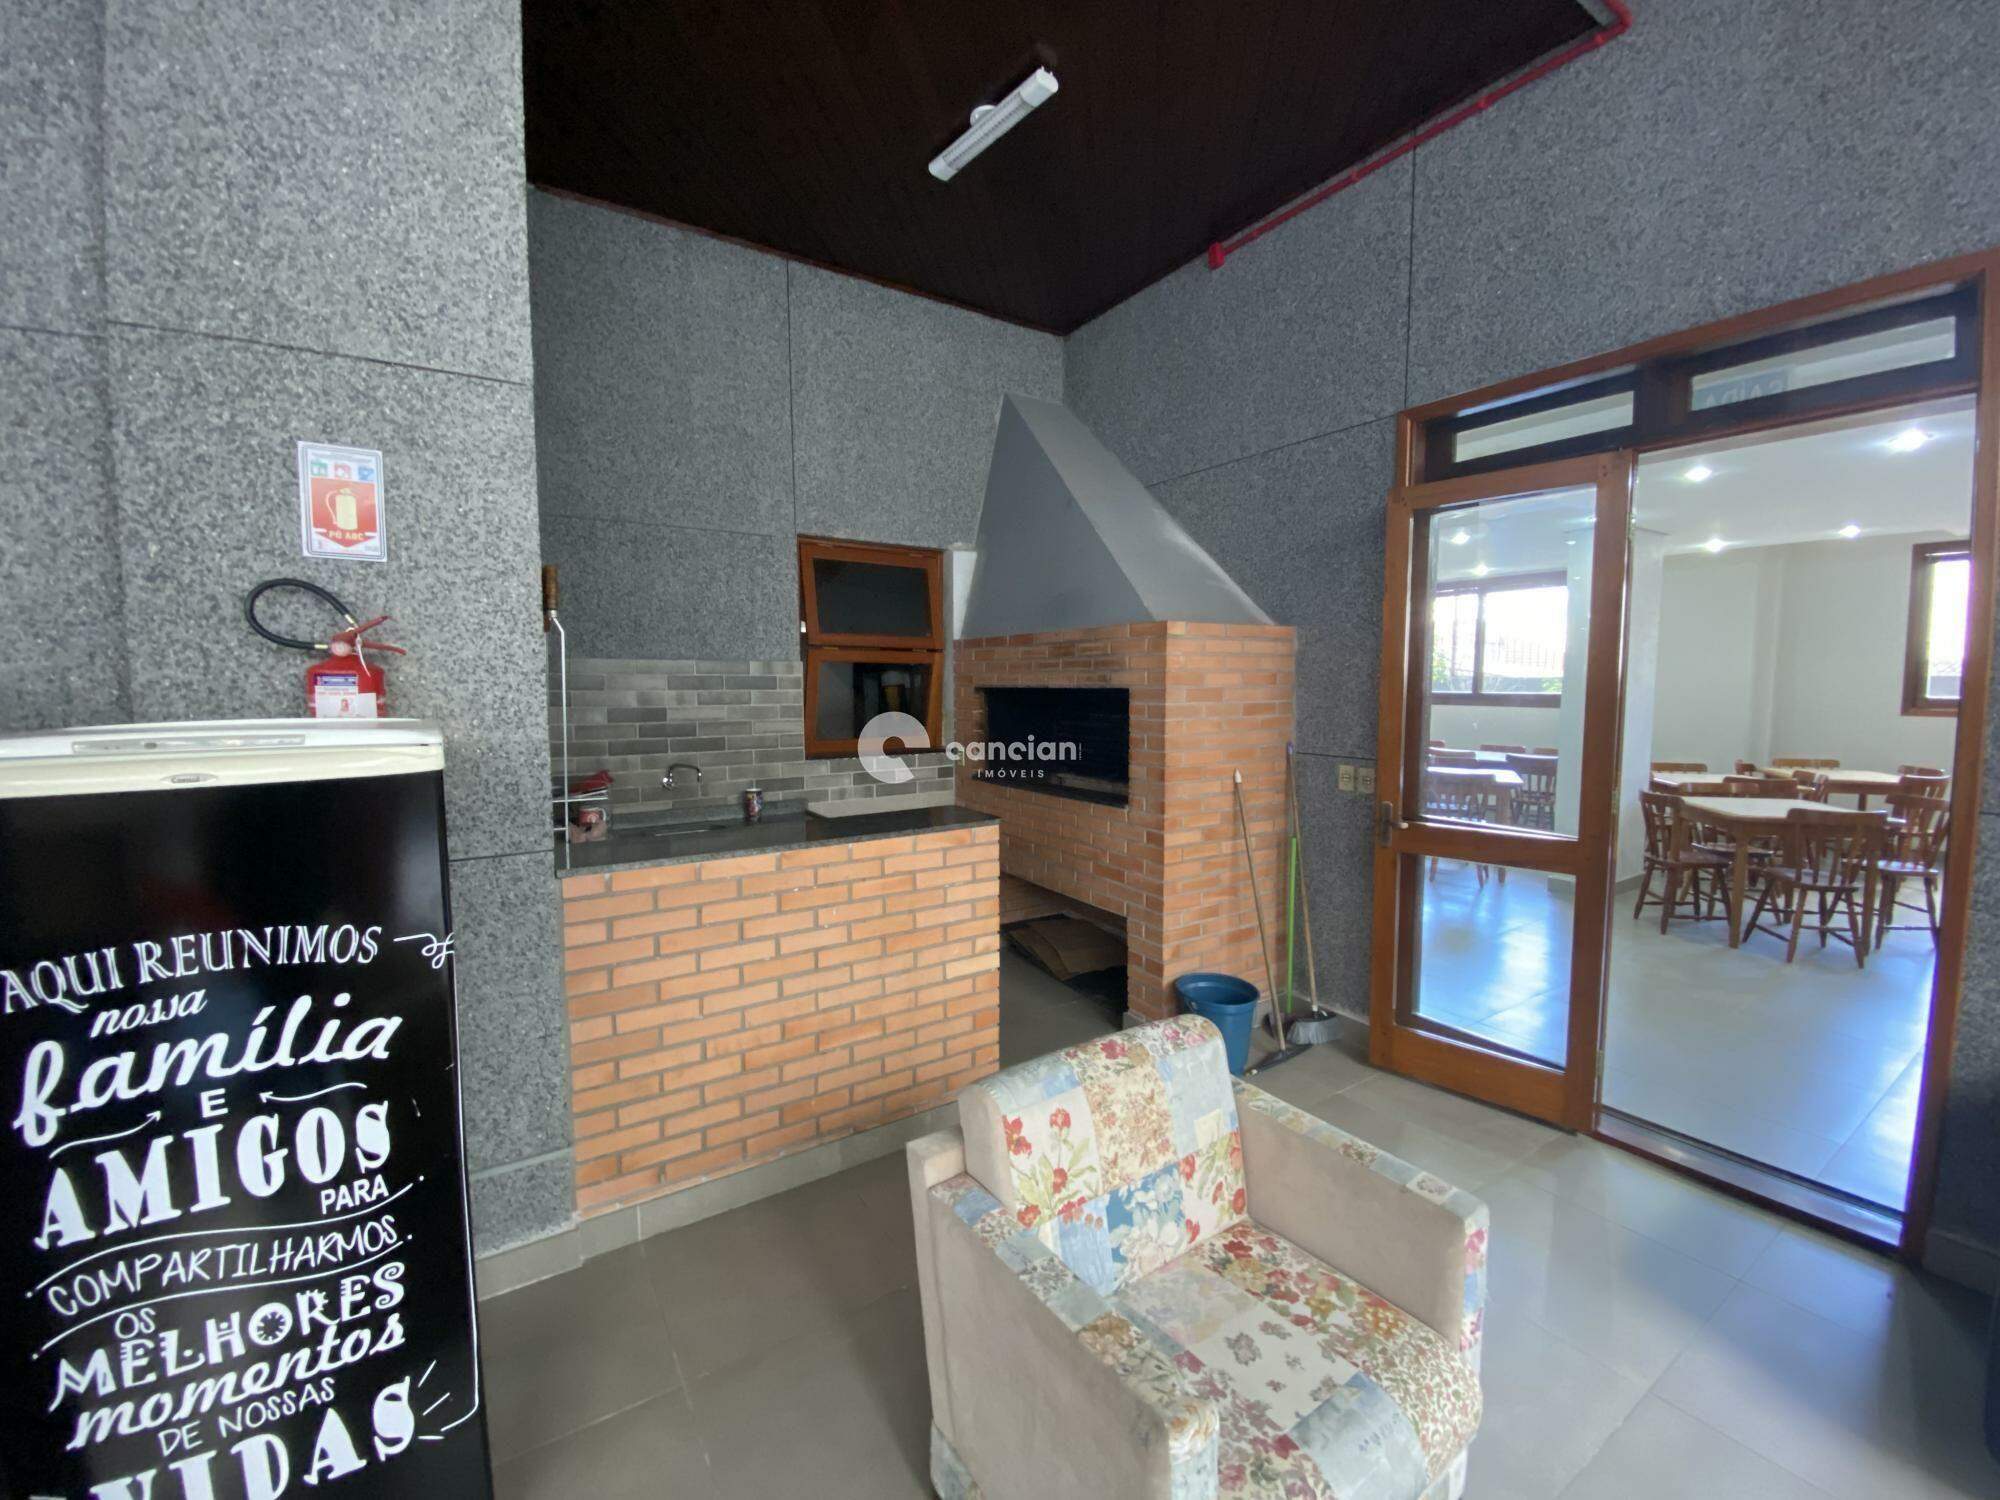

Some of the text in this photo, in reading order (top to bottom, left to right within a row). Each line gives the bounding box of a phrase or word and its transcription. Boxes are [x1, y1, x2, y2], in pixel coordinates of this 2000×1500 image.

[0, 924, 382, 1014] AQUI REUNIMOS
[90, 989, 206, 1038] nossa
[12, 992, 403, 1147] família
[200, 1088, 228, 1118] E
[34, 1101, 392, 1250] AMIGOS
[320, 1174, 389, 1214] PARA
[48, 1214, 398, 1316] COMPARTILHARMOS
[47, 1262, 405, 1413] MELHORES
[114, 1308, 156, 1339] OS
[66, 1312, 405, 1451] momentos
[158, 1377, 336, 1456] DE NOSSAS
